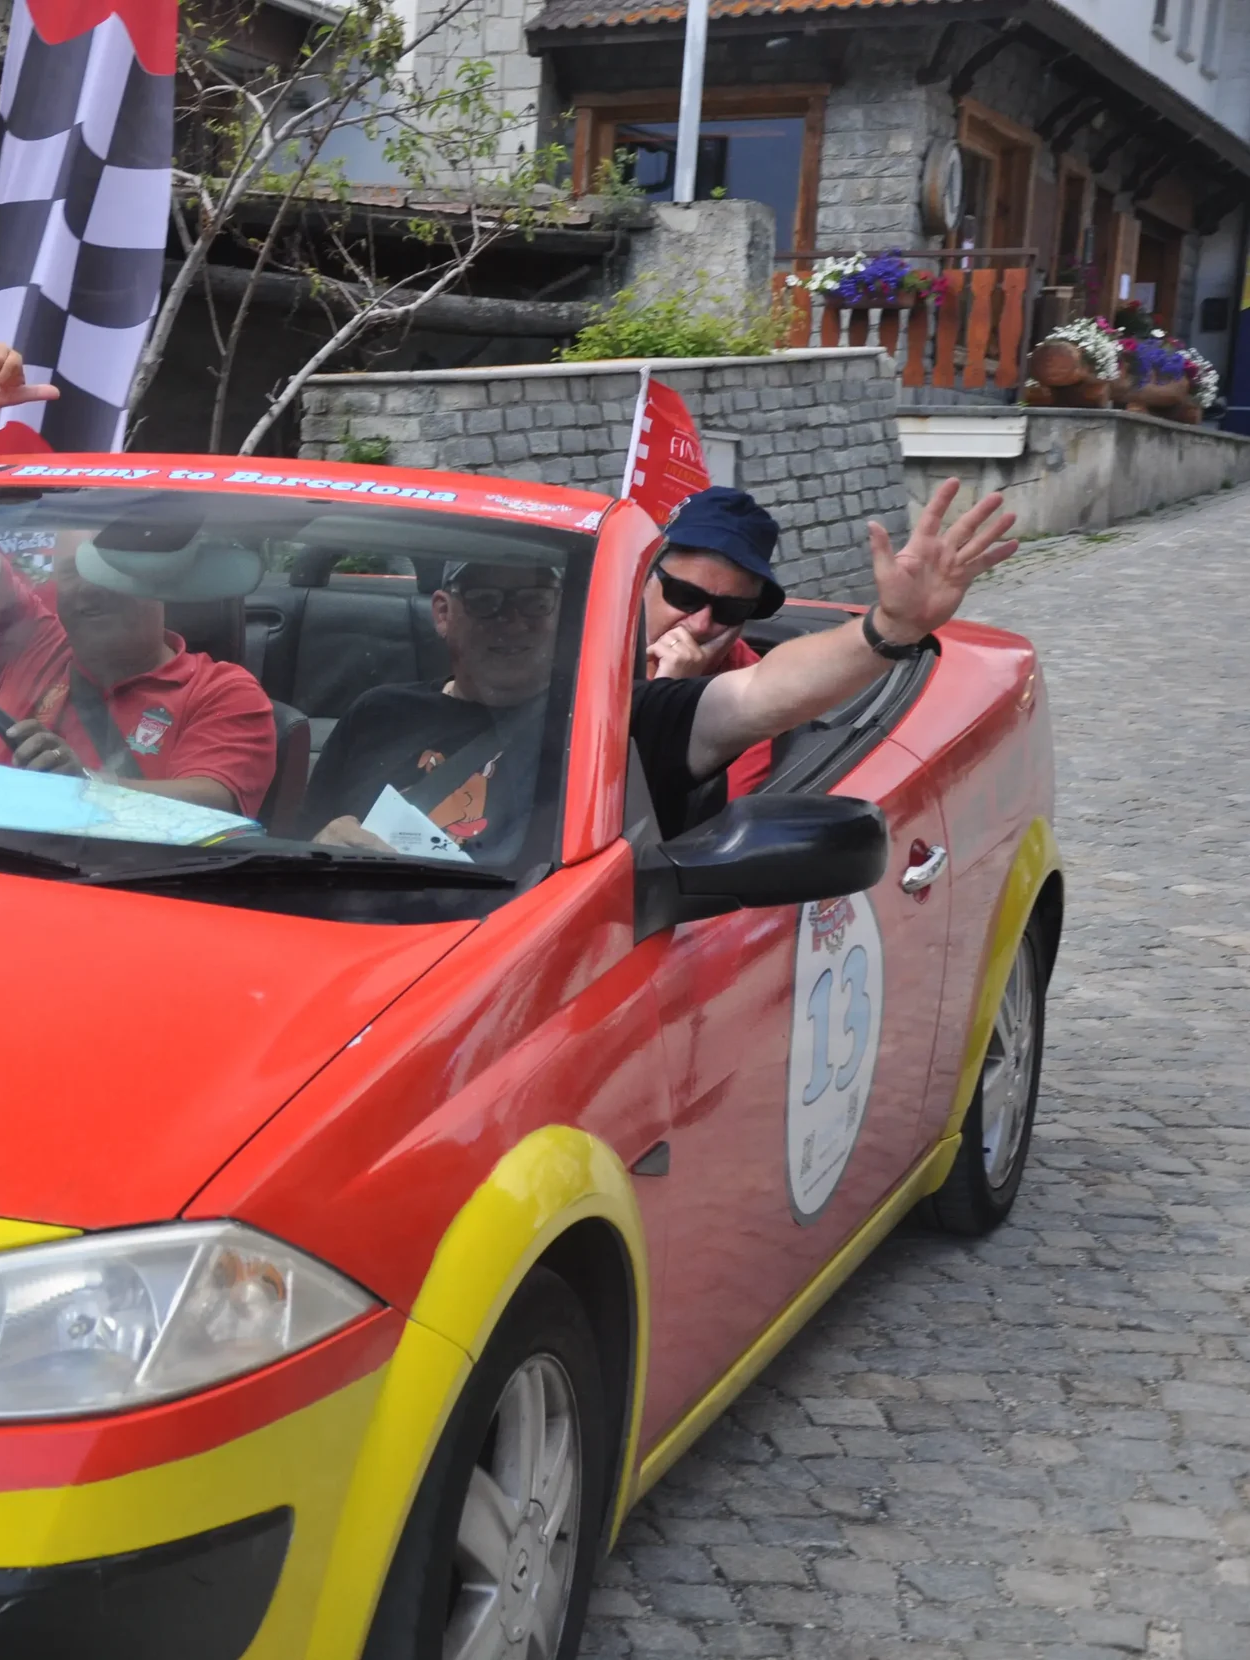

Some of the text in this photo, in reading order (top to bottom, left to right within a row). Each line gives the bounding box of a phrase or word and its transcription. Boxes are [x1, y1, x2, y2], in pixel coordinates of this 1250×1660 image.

[9, 464, 458, 503] Barmy to Barcelona
[802, 944, 871, 1106] 13
